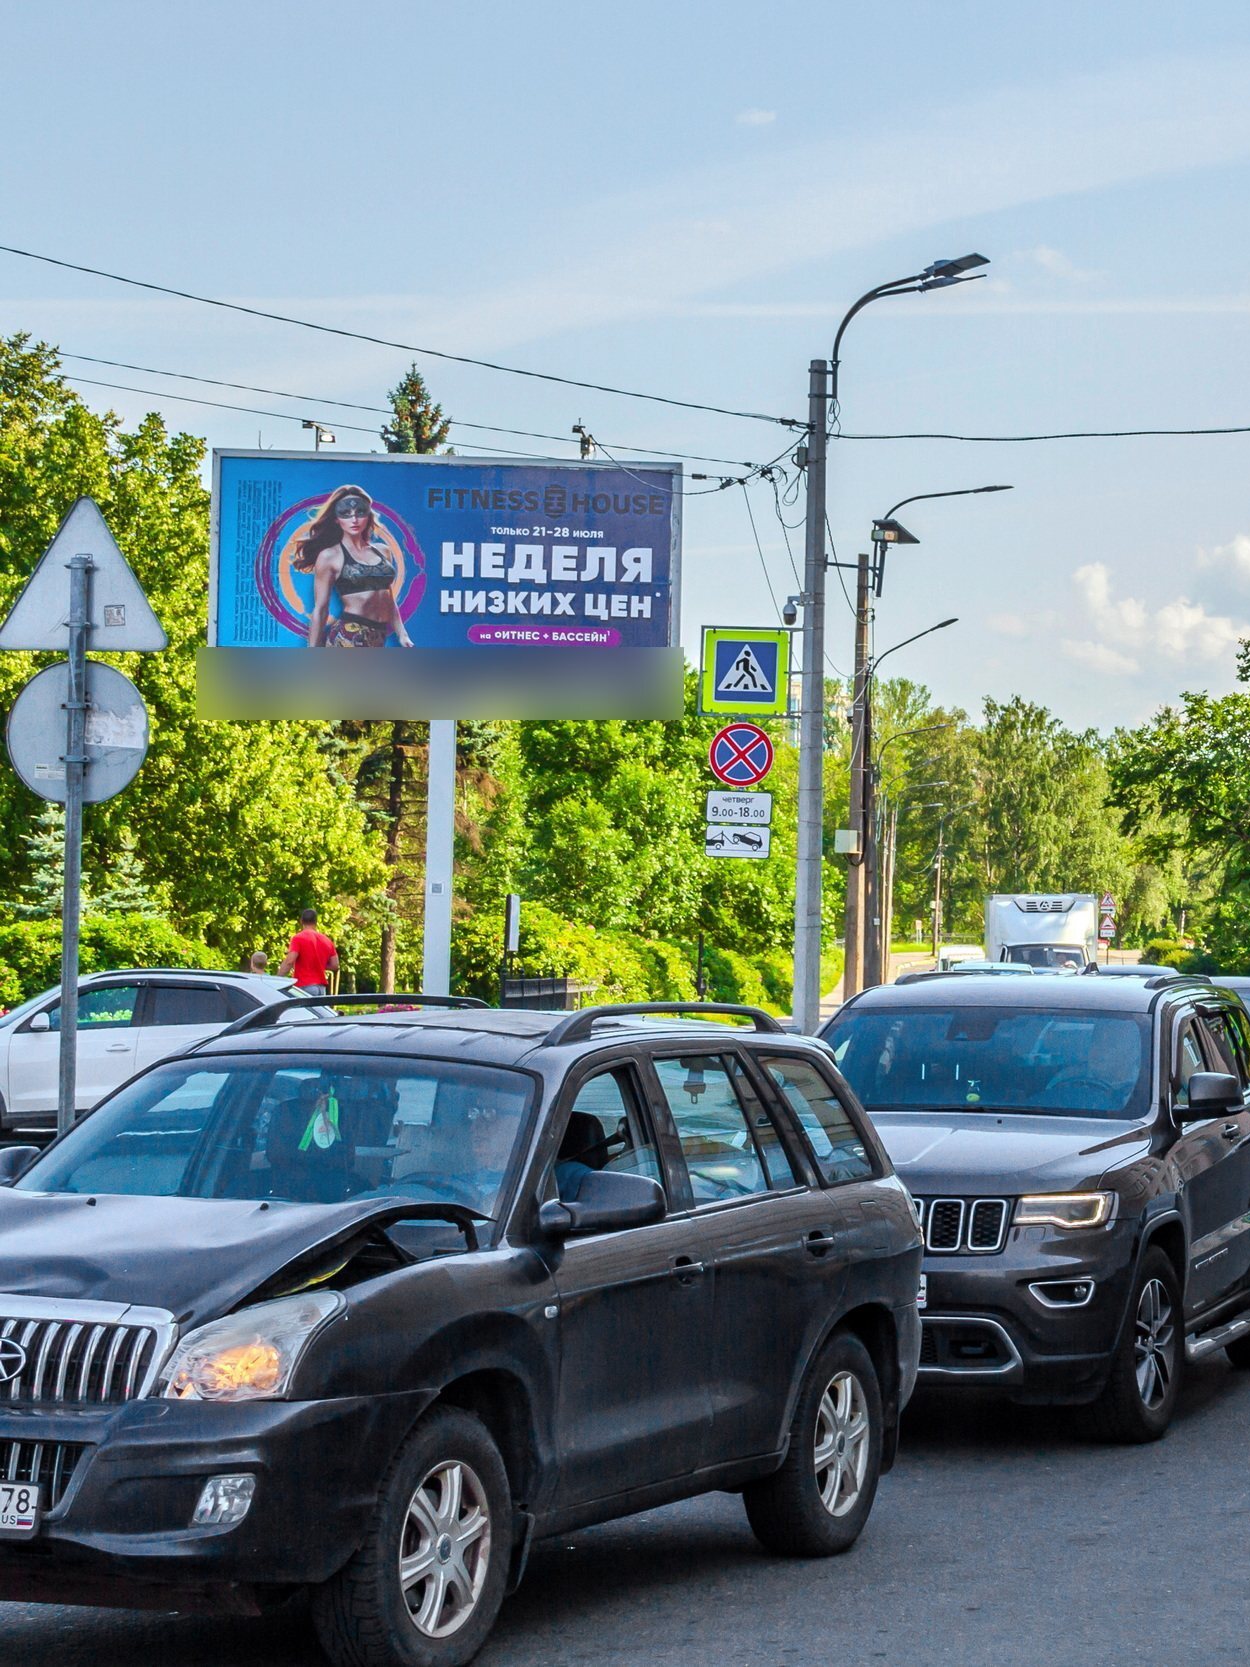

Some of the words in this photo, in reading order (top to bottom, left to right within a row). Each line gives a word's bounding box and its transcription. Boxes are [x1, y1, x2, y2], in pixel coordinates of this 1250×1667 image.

[427, 487, 540, 512] FITNESS
[572, 492, 664, 515] HOUSE
[491, 526, 530, 537] только
[572, 529, 604, 539] июля
[441, 541, 653, 584] НЕДЕЛЯ
[440, 590, 576, 616] НИЗКИХ
[494, 630, 540, 641] ФИТНЕС
[722, 796, 755, 805] четверг
[1, 1487, 30, 1514] 78
